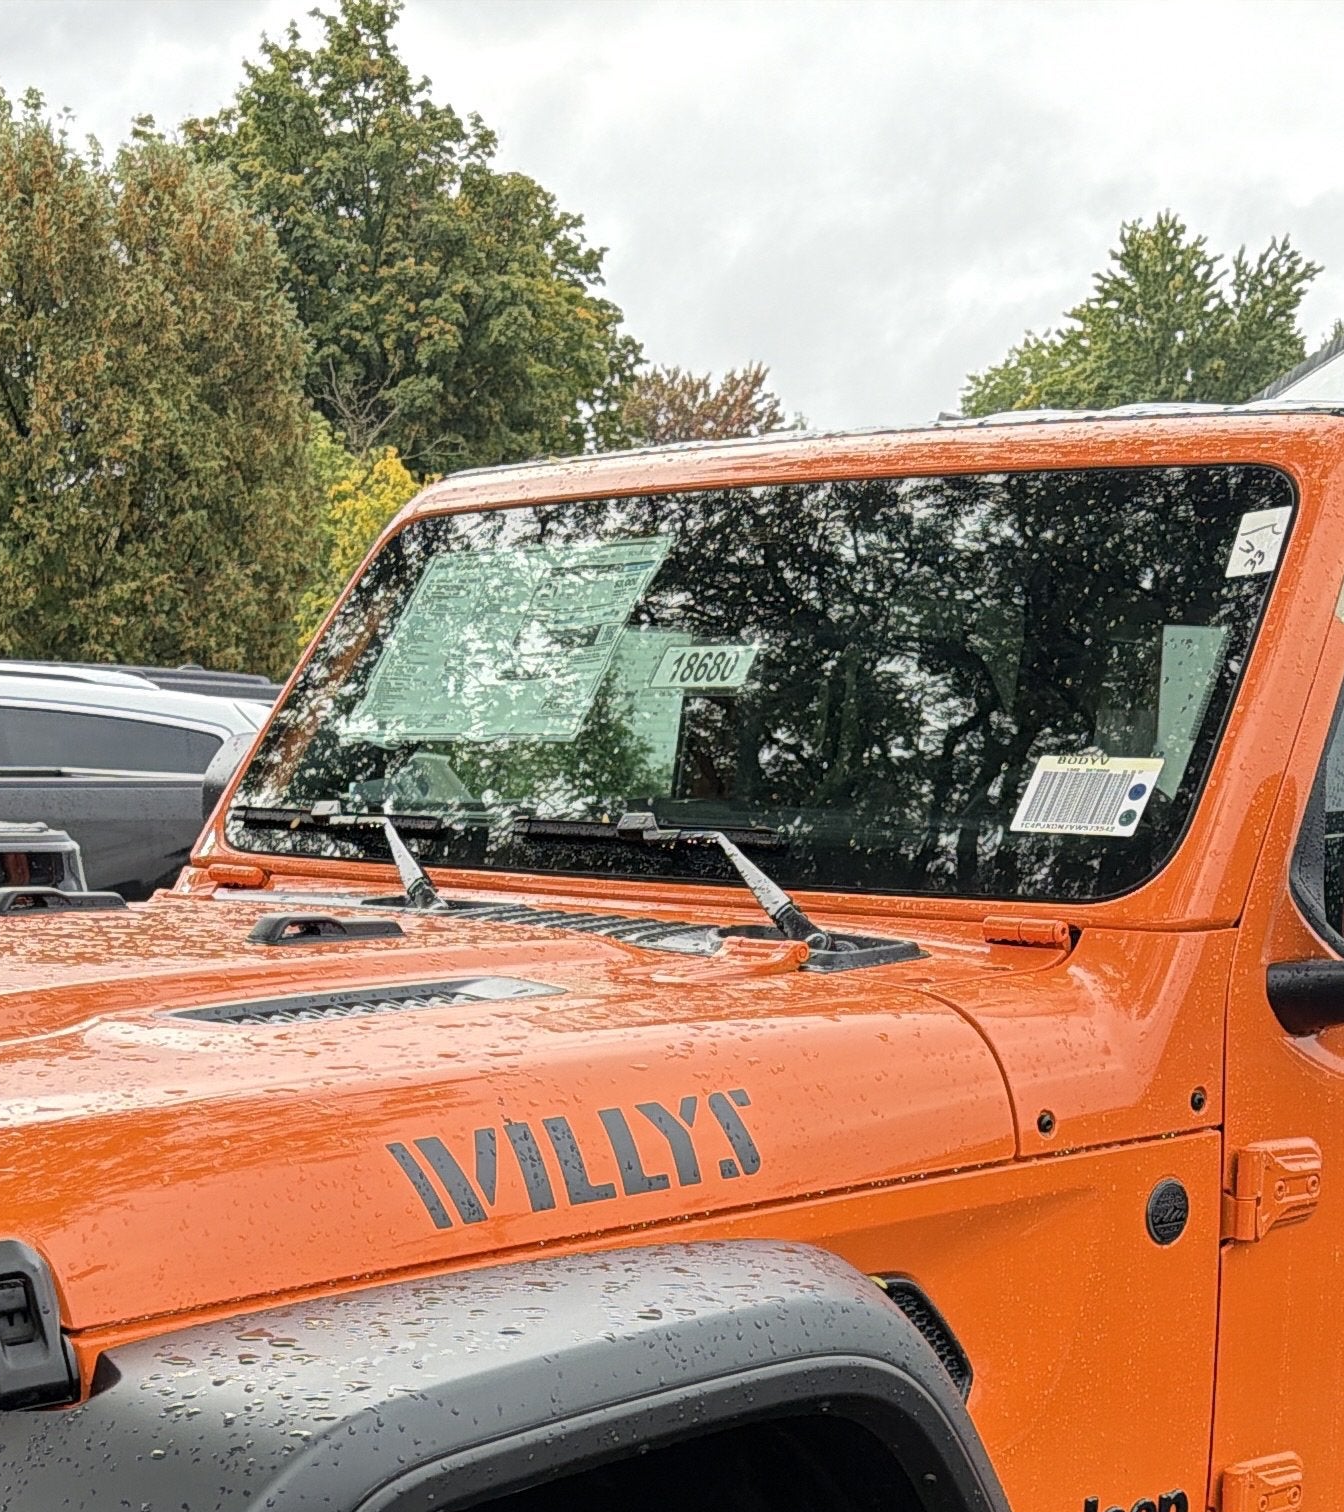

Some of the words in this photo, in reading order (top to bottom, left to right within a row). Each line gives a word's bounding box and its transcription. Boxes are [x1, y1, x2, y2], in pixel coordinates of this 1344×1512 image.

[1243, 549, 1265, 573] 33
[668, 651, 740, 683] 18680
[385, 1089, 762, 1230] WILLYS
